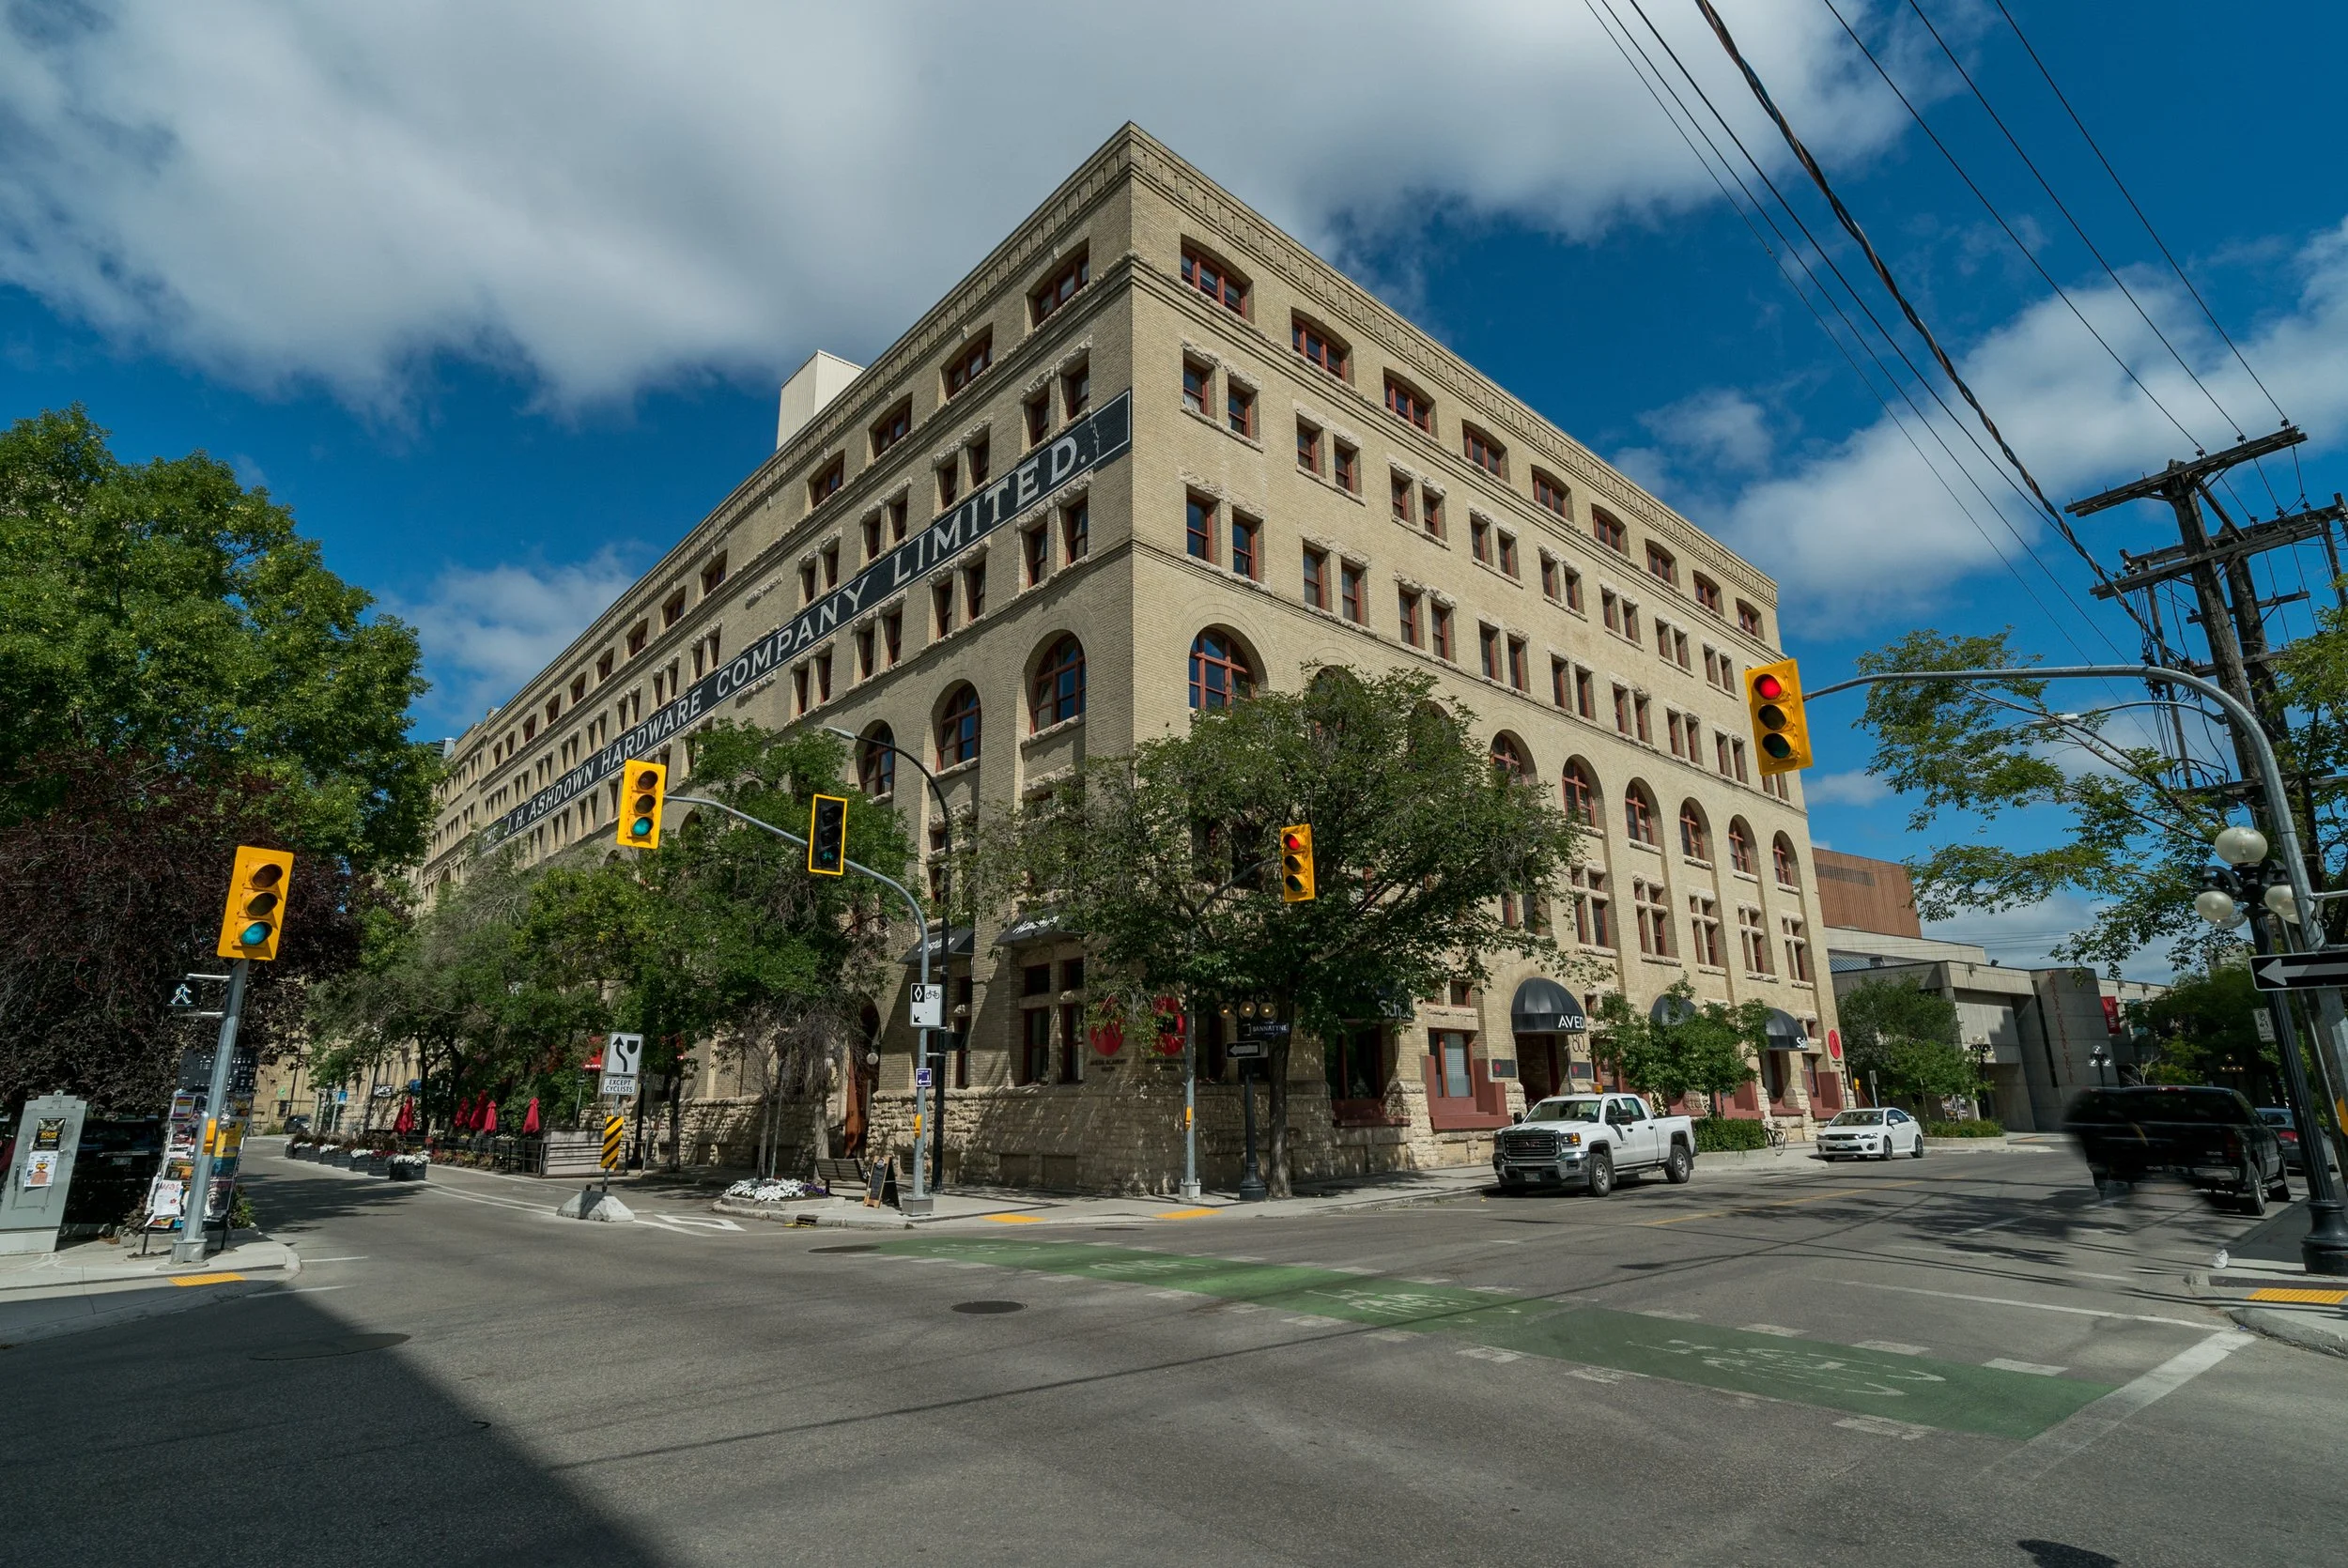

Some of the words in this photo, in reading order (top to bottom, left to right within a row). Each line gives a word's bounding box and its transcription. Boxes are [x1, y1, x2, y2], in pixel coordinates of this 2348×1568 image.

[503, 808, 525, 836] J.H.
[528, 761, 595, 822] ASHDOWN
[601, 688, 703, 776] HARDWARE
[717, 576, 870, 698] COMPANY
[893, 436, 1086, 587] LIMITED.
